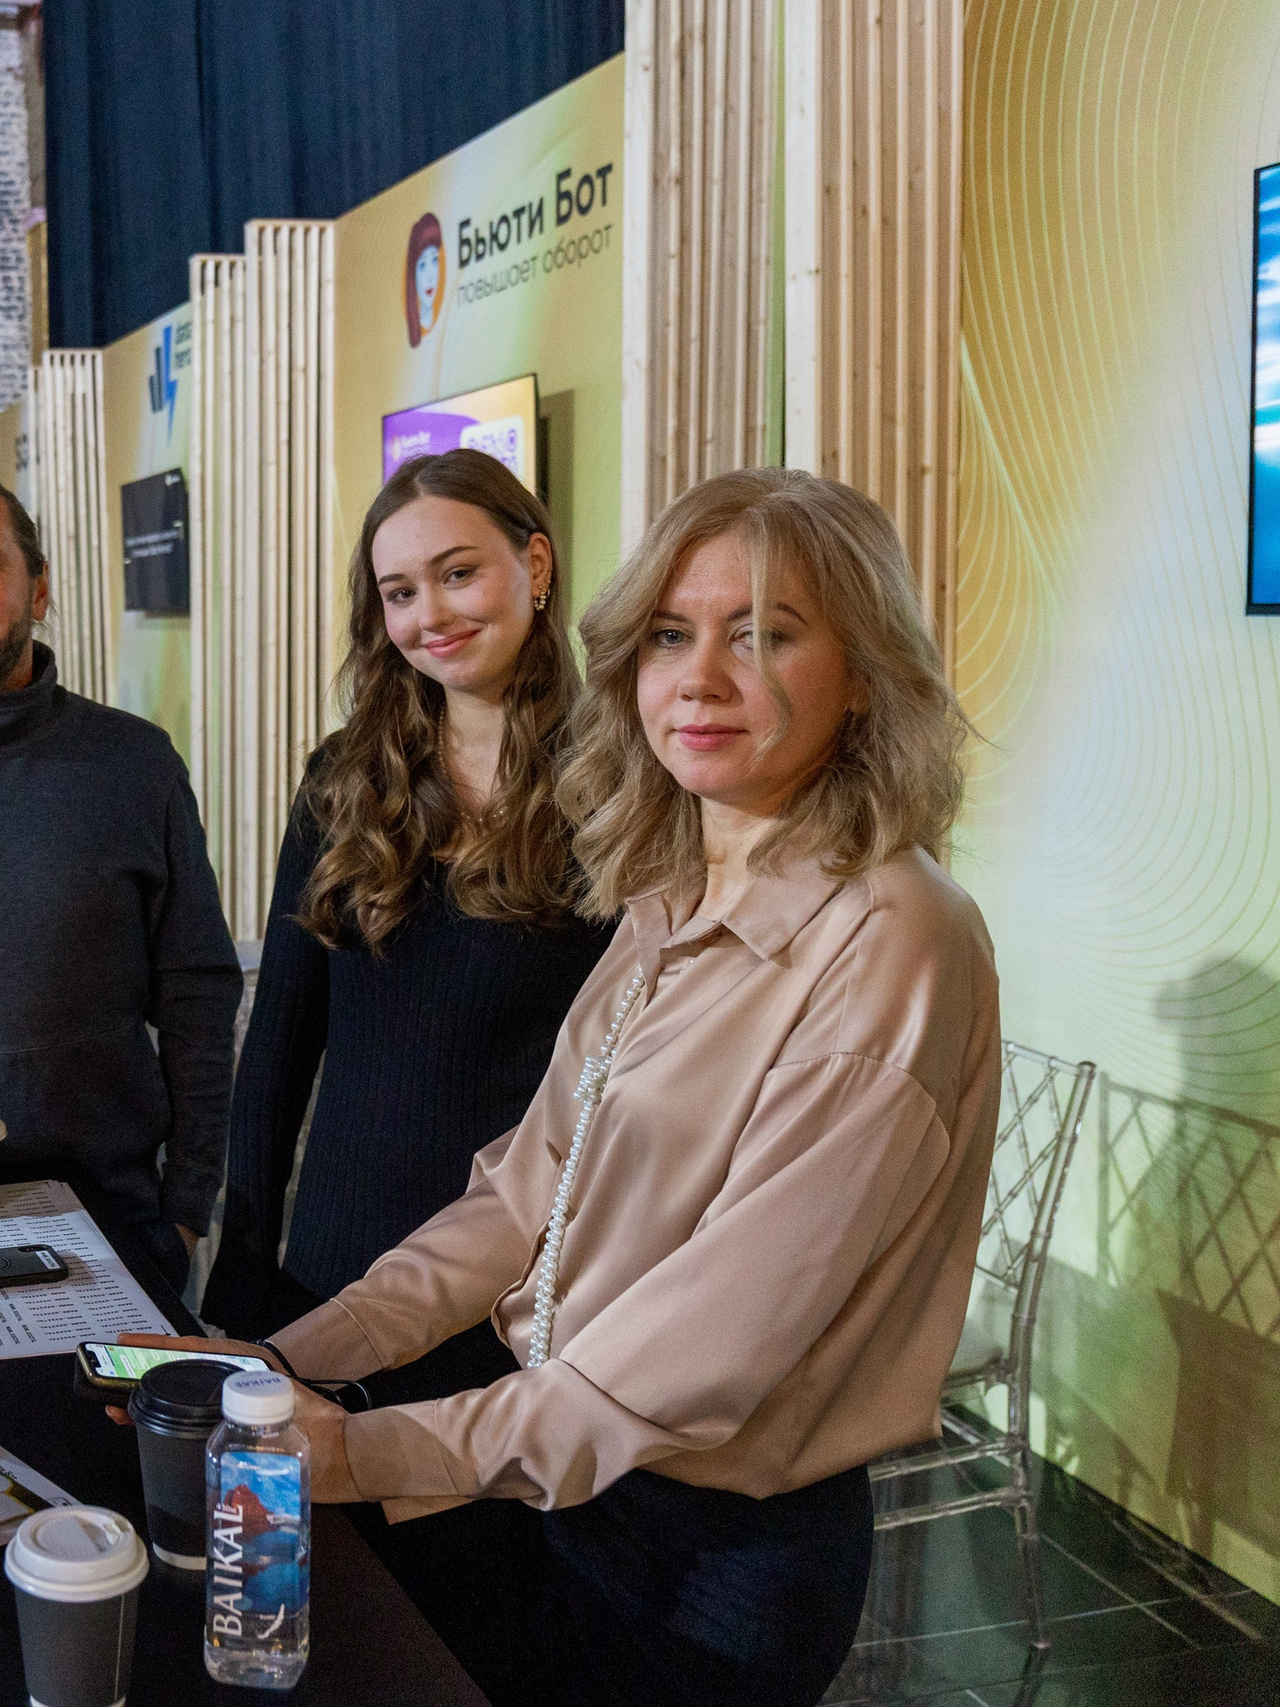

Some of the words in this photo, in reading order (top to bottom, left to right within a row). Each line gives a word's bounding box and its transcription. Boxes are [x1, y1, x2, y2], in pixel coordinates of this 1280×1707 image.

[457, 254, 539, 307] повышает
[541, 224, 613, 274] оборот
[458, 197, 544, 269] Бьюти
[555, 163, 613, 228] Бот
[213, 1503, 244, 1637] BAIKAL
